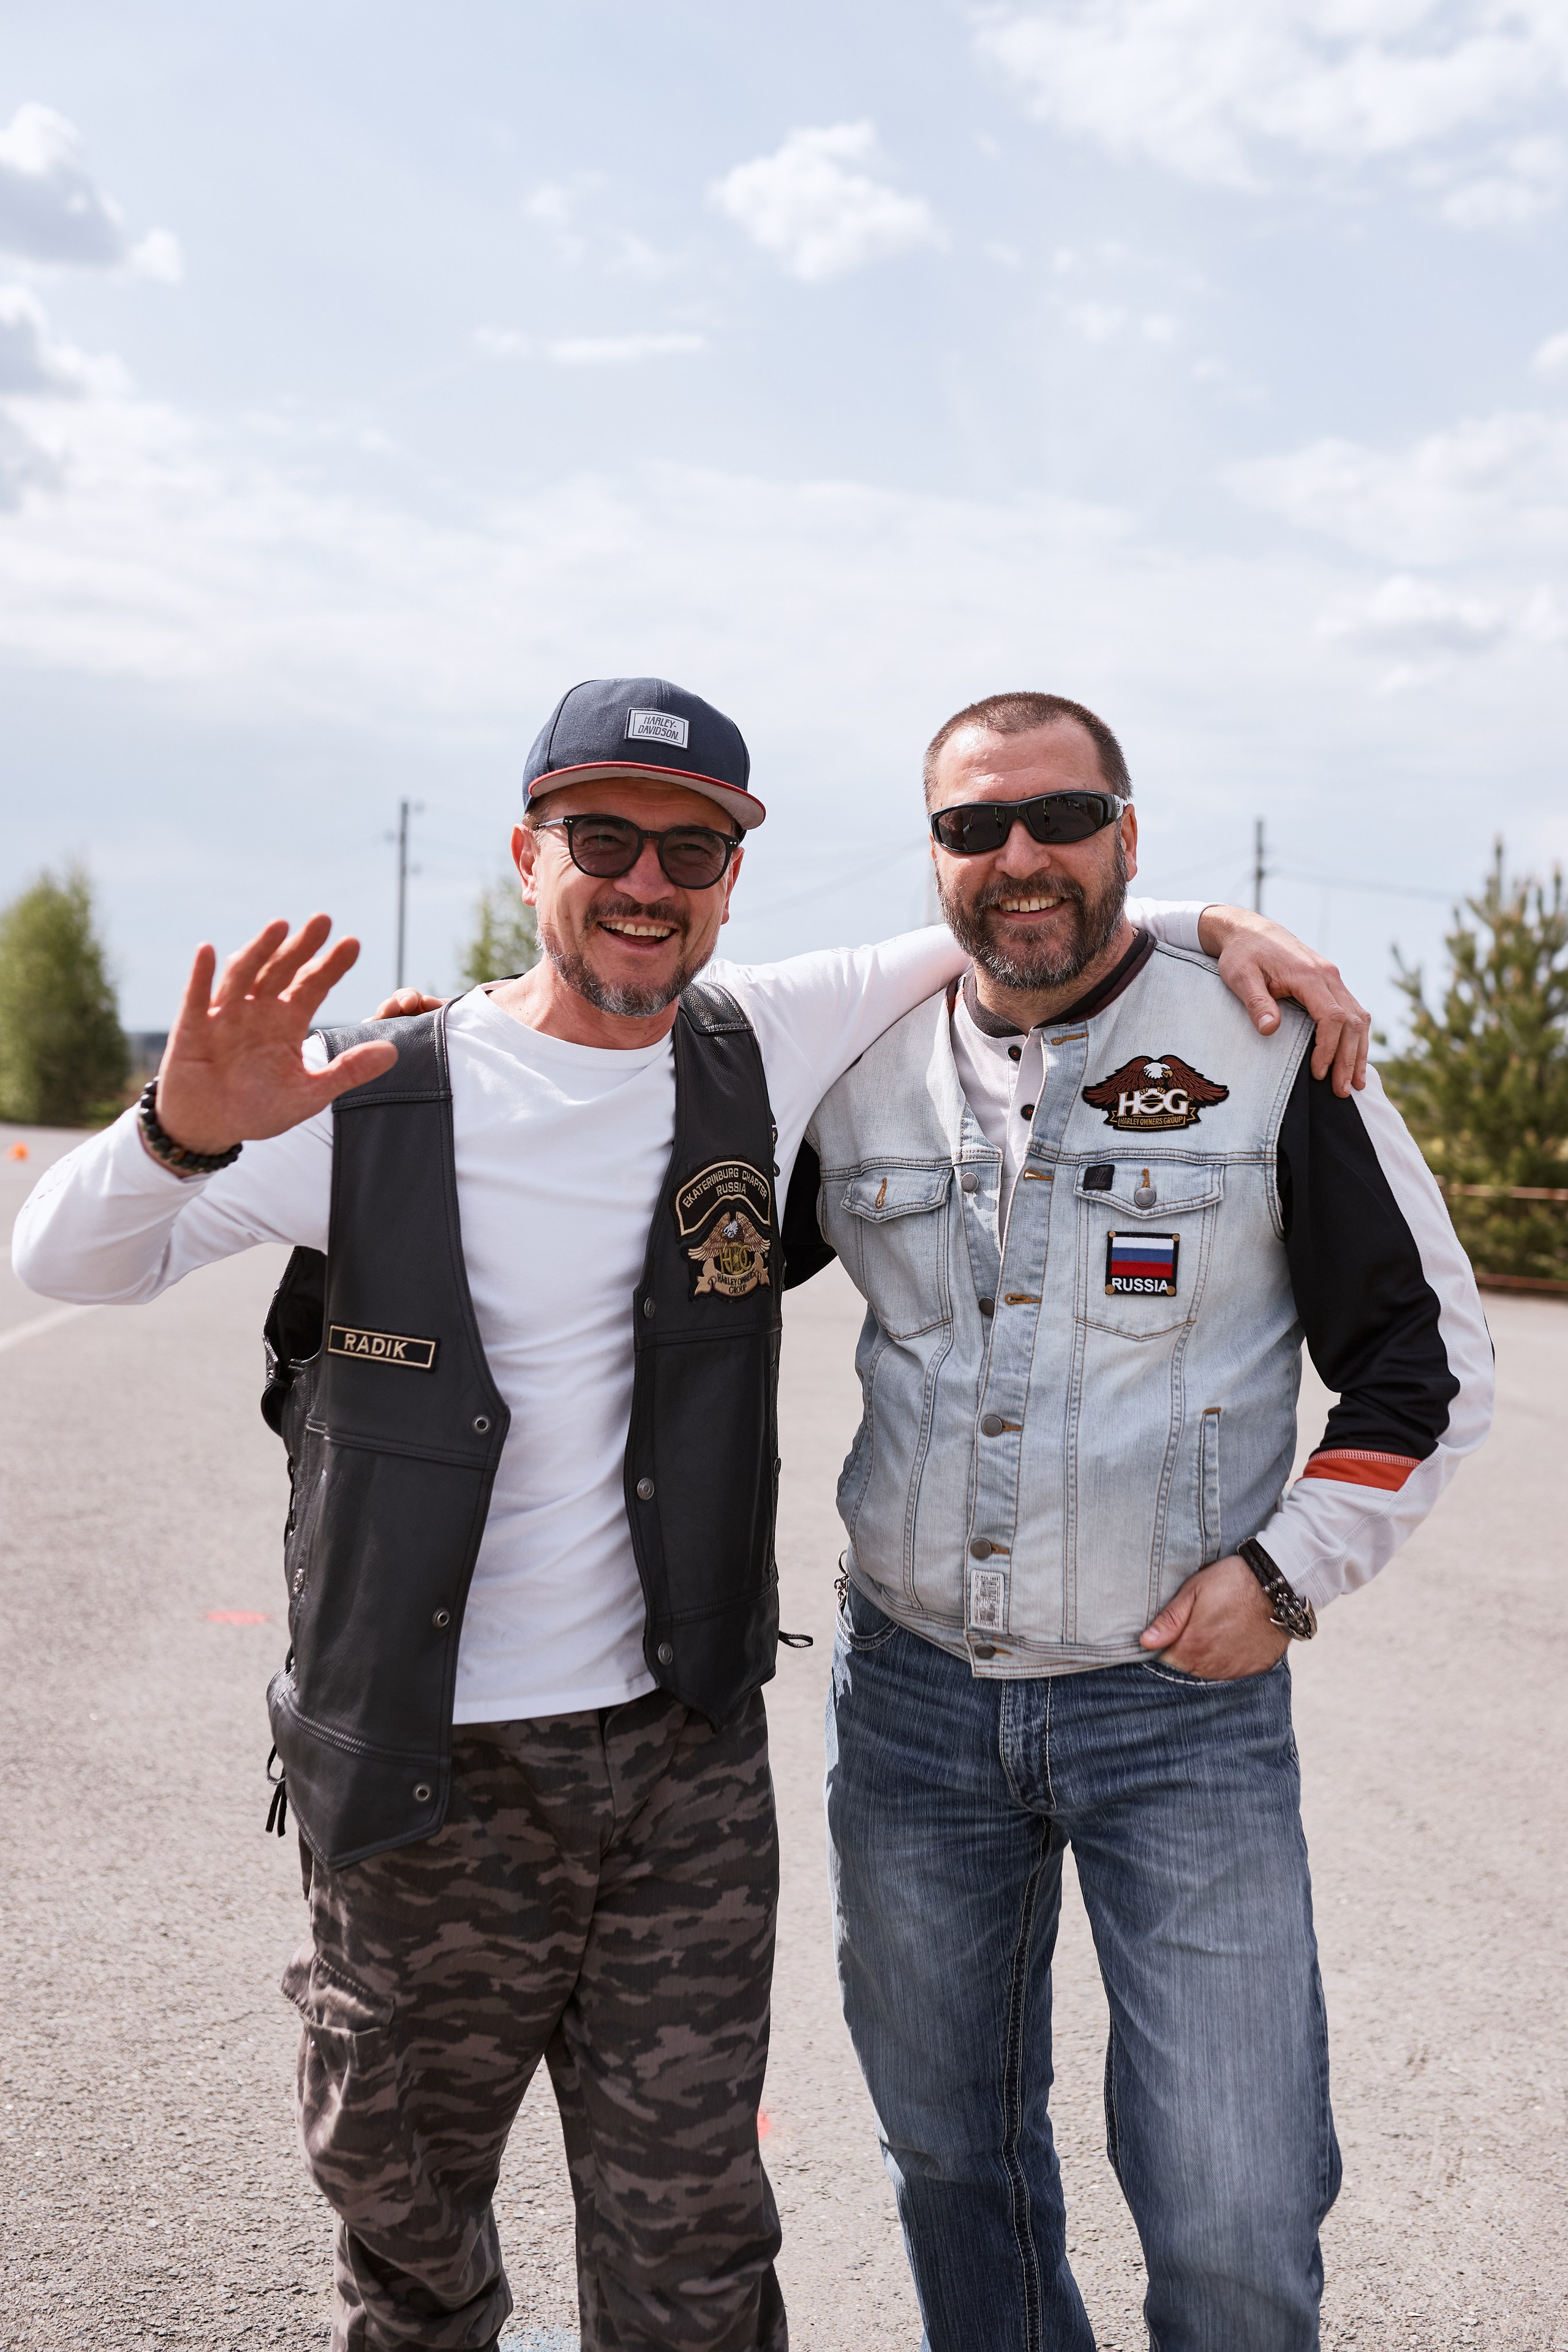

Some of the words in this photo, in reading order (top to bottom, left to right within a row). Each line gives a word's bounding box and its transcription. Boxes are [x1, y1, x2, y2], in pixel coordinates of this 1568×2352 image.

[644, 716, 677, 729] HARLEY-
[1116, 1088, 1190, 1117] HOG
[1163, 1116, 1183, 1125] GROUP
[682, 1167, 739, 1208] EKATERINBURG
[742, 1170, 767, 1200] CHAPTER
[716, 1182, 747, 1196] RUSSIA
[717, 1273, 737, 1286] HARLEY
[1112, 1278, 1168, 1292] RUSSIA
[729, 1284, 747, 1294] GROUP
[344, 1333, 409, 1359] RADIK
